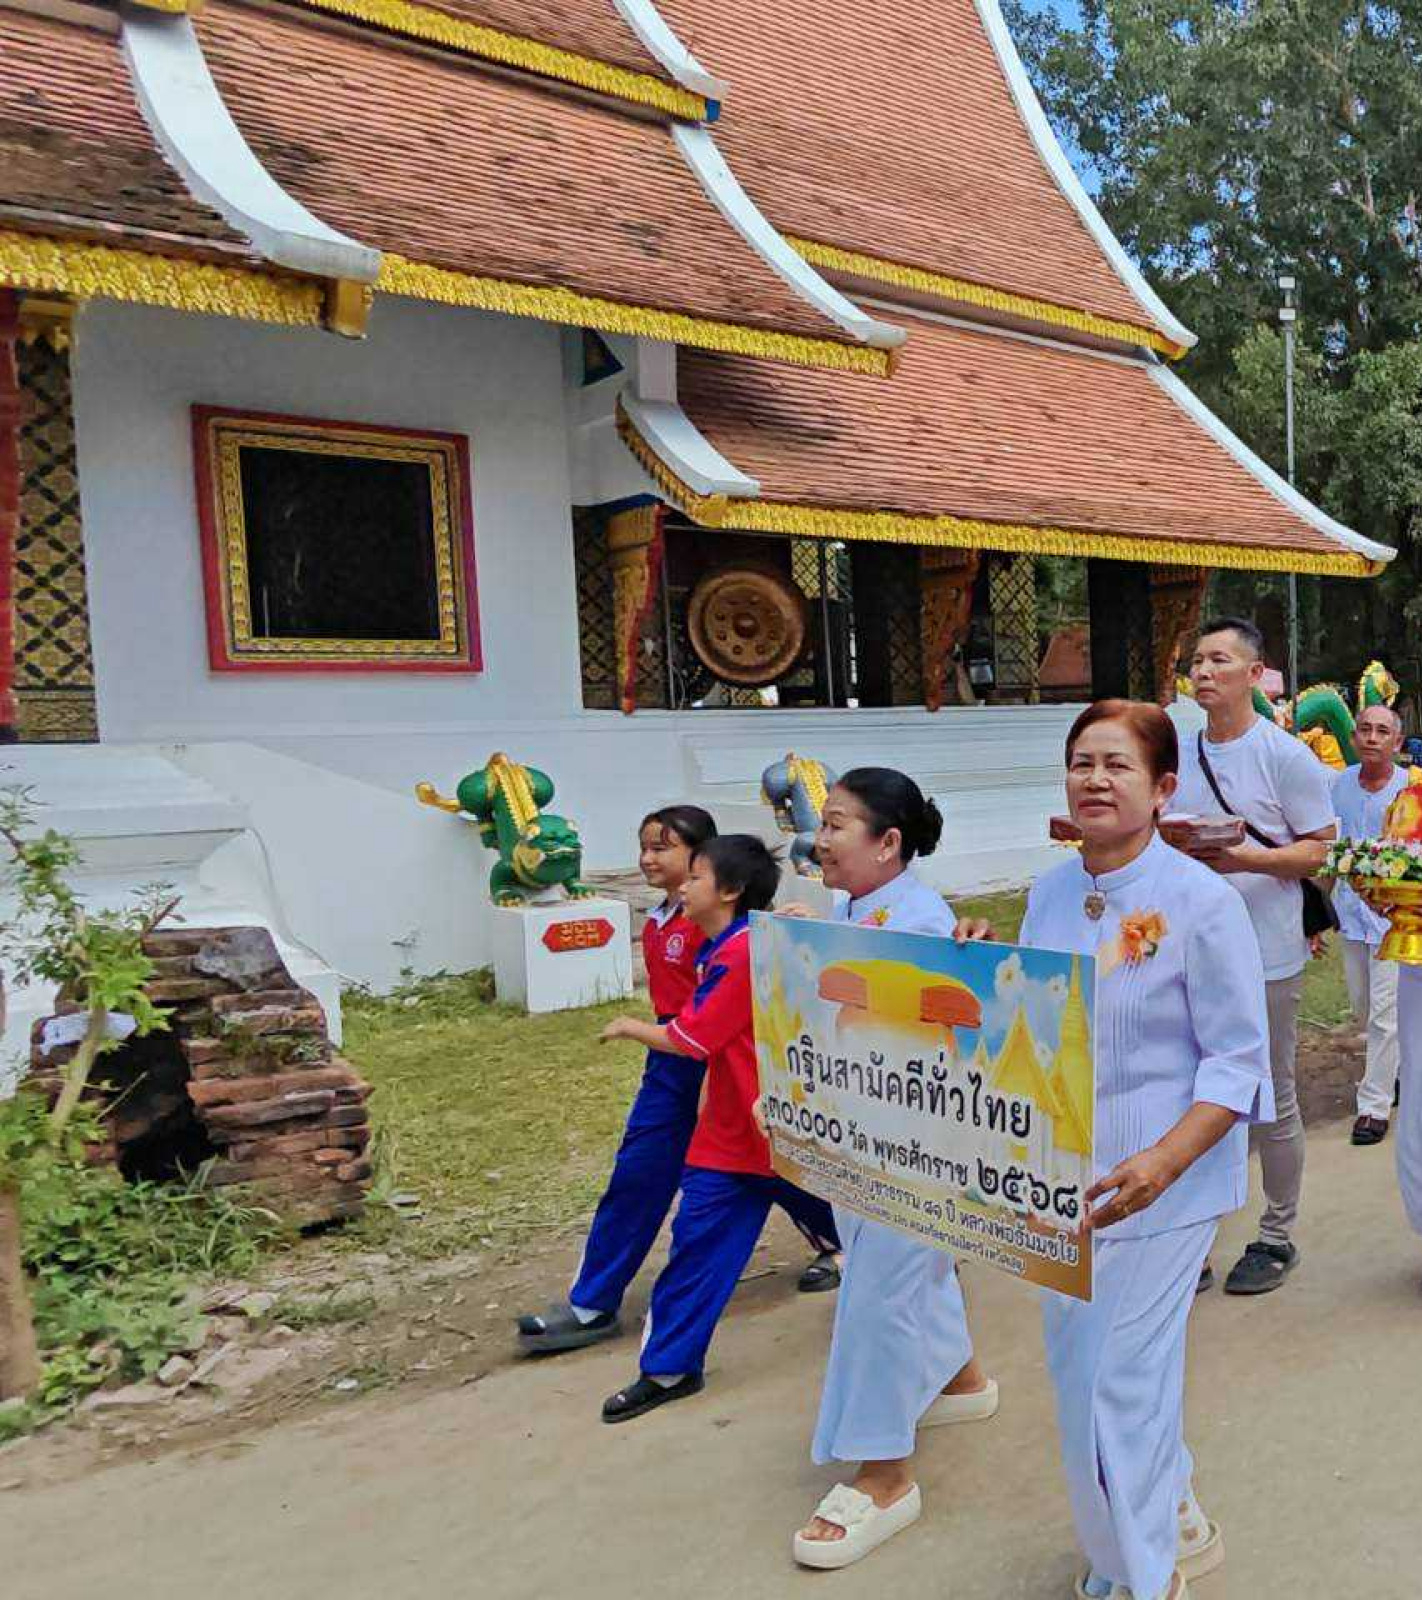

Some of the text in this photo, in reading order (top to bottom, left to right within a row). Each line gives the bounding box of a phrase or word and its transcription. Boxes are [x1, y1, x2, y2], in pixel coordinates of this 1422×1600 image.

[786, 1034, 1031, 1138] กฐินสามัคคีทั่วไทย
[847, 1119, 869, 1154] วัด
[873, 1137, 969, 1186] พุทธศักราช
[977, 1158, 1079, 1219] ๒๕๖๘
